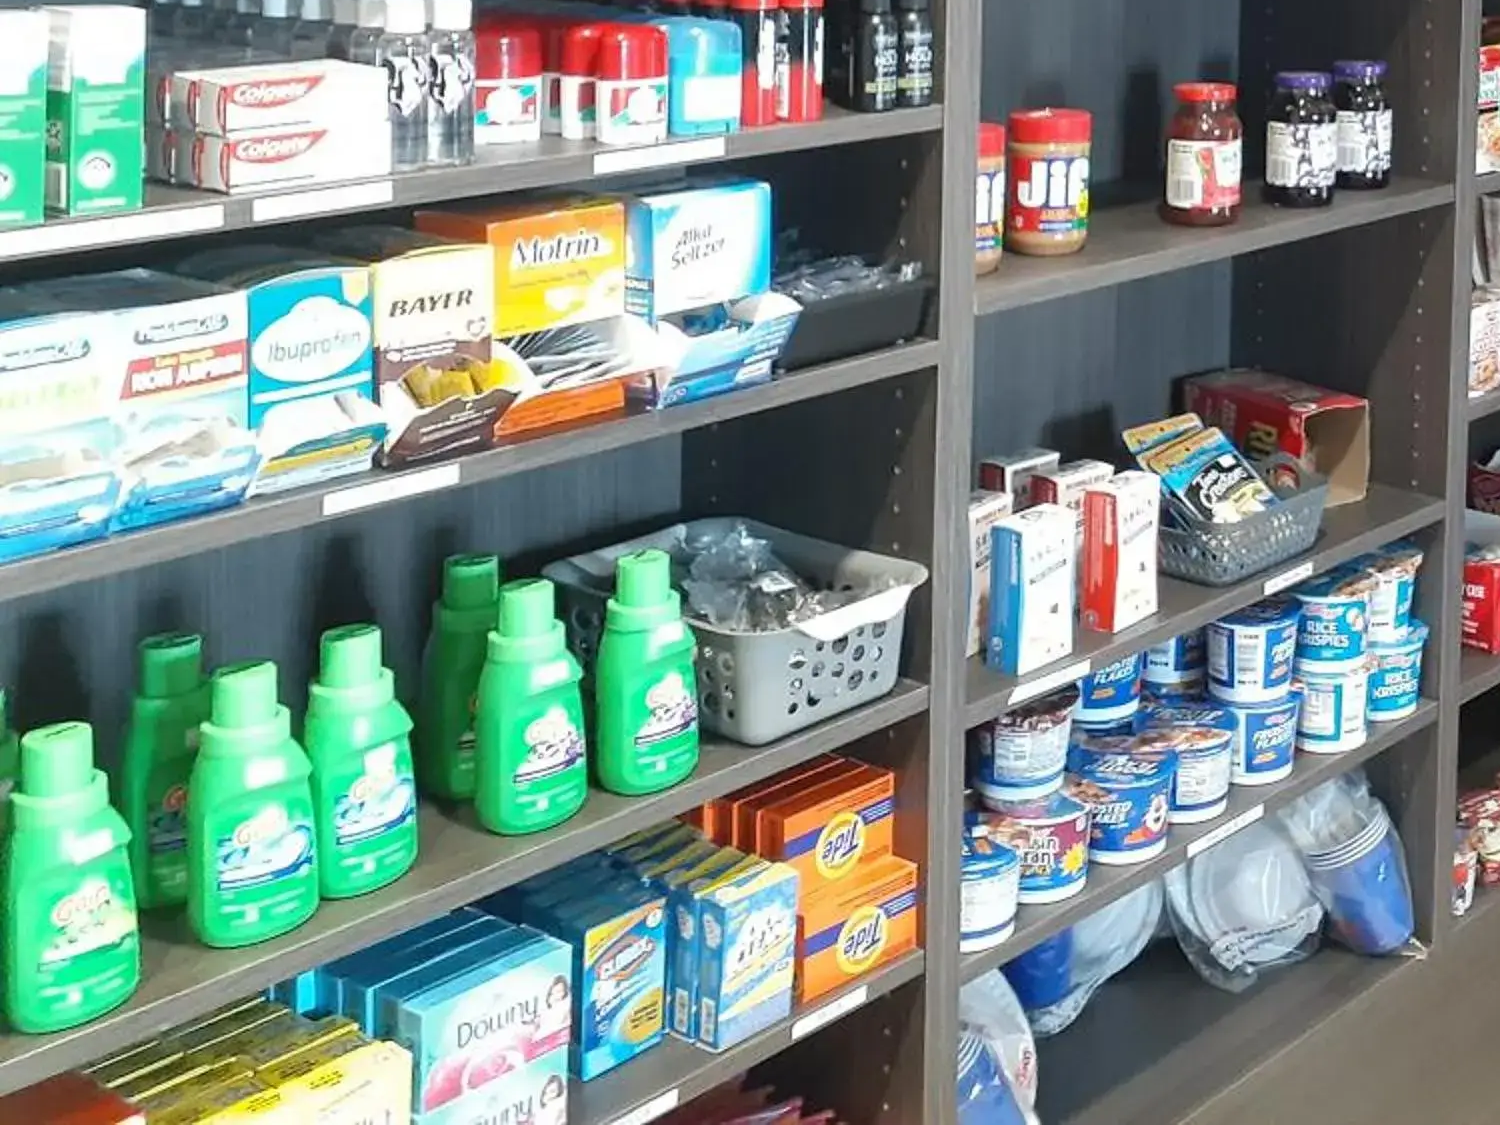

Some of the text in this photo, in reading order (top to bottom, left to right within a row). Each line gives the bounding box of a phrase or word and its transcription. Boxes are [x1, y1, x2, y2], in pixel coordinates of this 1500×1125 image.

[1017, 157, 1089, 208] Jif
[514, 229, 601, 266] Motrin
[388, 287, 475, 318] BAYER
[267, 329, 362, 365] Ibuprofen
[821, 819, 860, 864] Tide
[1022, 850, 1052, 865] ran
[843, 911, 881, 960] Tide
[457, 995, 540, 1049] Downy
